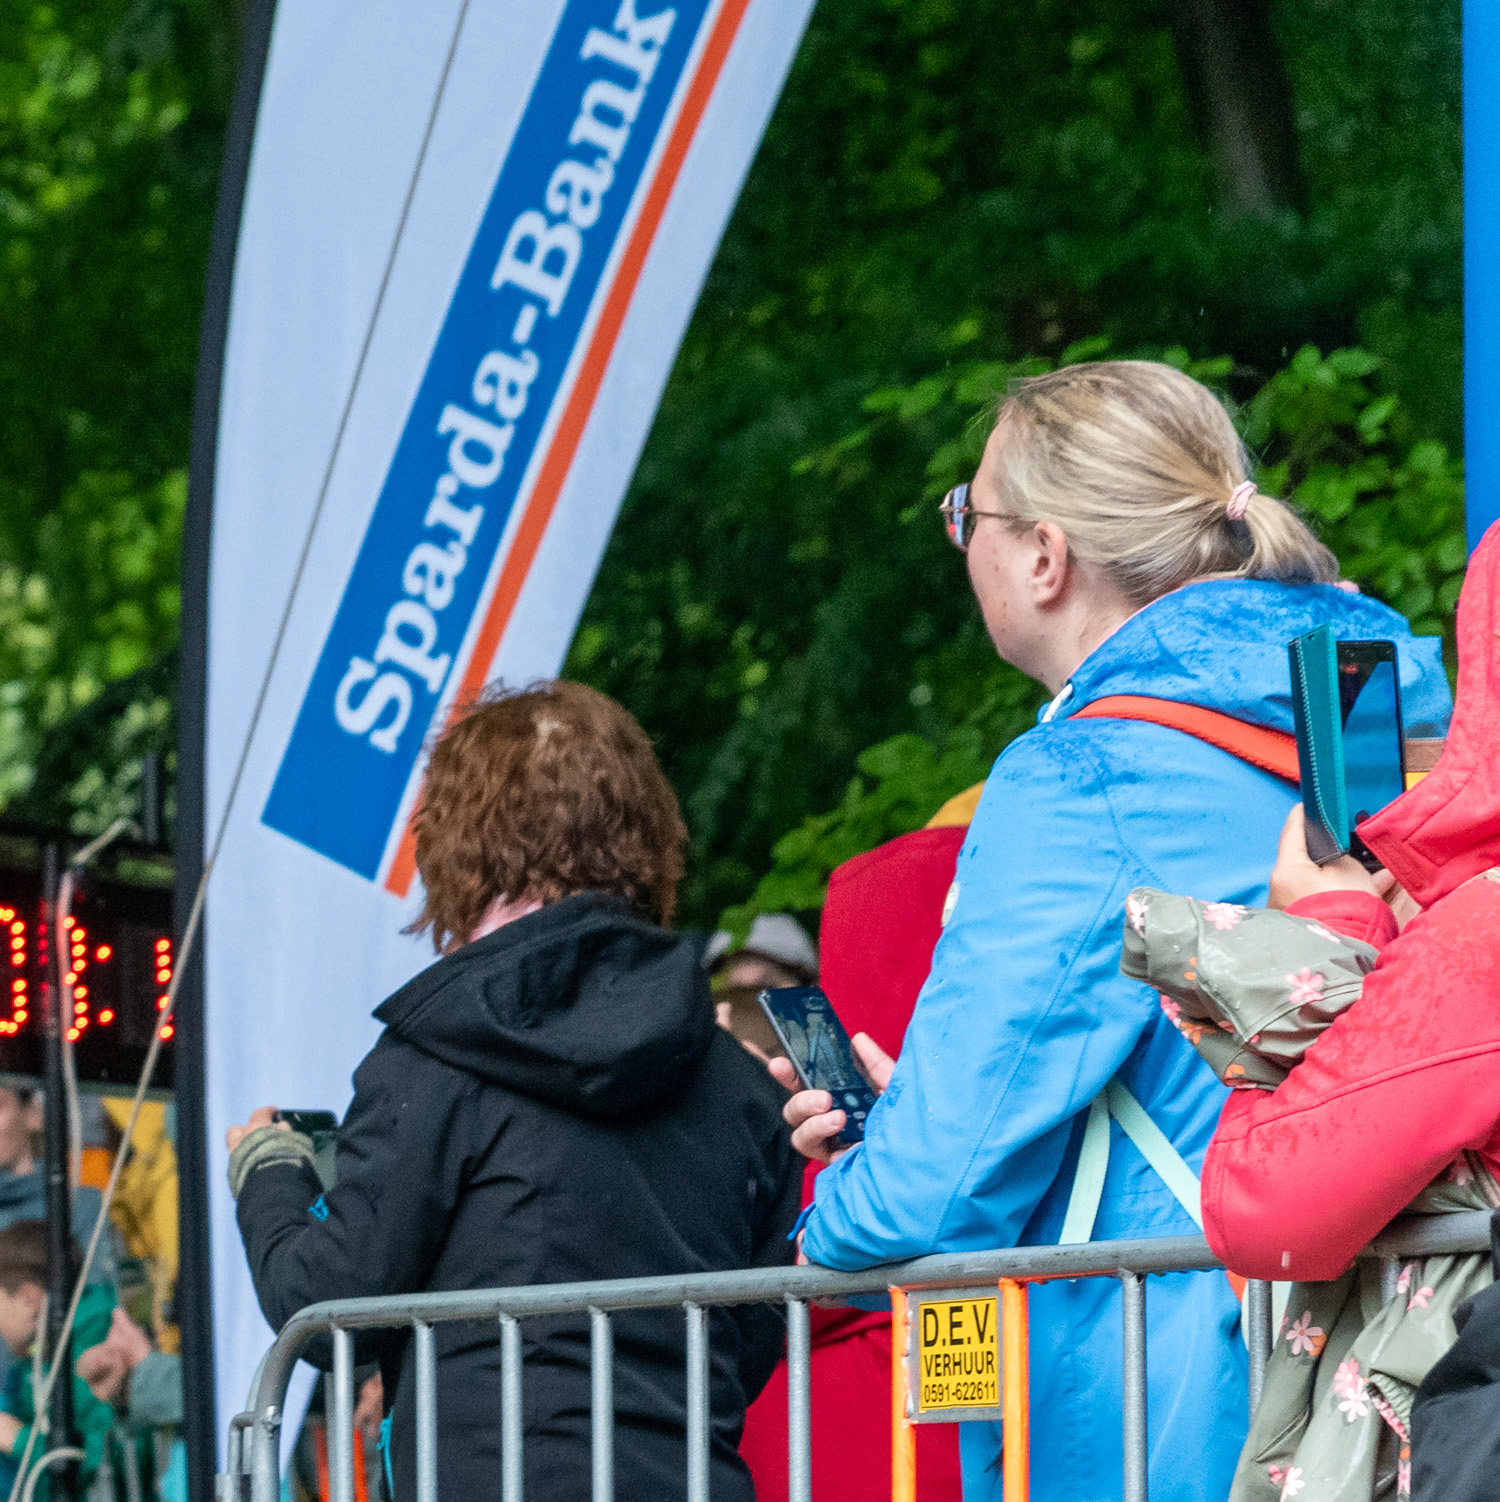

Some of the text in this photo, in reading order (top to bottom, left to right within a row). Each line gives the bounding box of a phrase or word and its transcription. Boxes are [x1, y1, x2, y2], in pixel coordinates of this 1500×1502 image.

[334, 0, 677, 754] Sparda-Bank
[923, 1303, 994, 1347] D.E.V.
[924, 1350, 995, 1378] VERHUUR
[923, 1381, 996, 1403] 0591-622611
